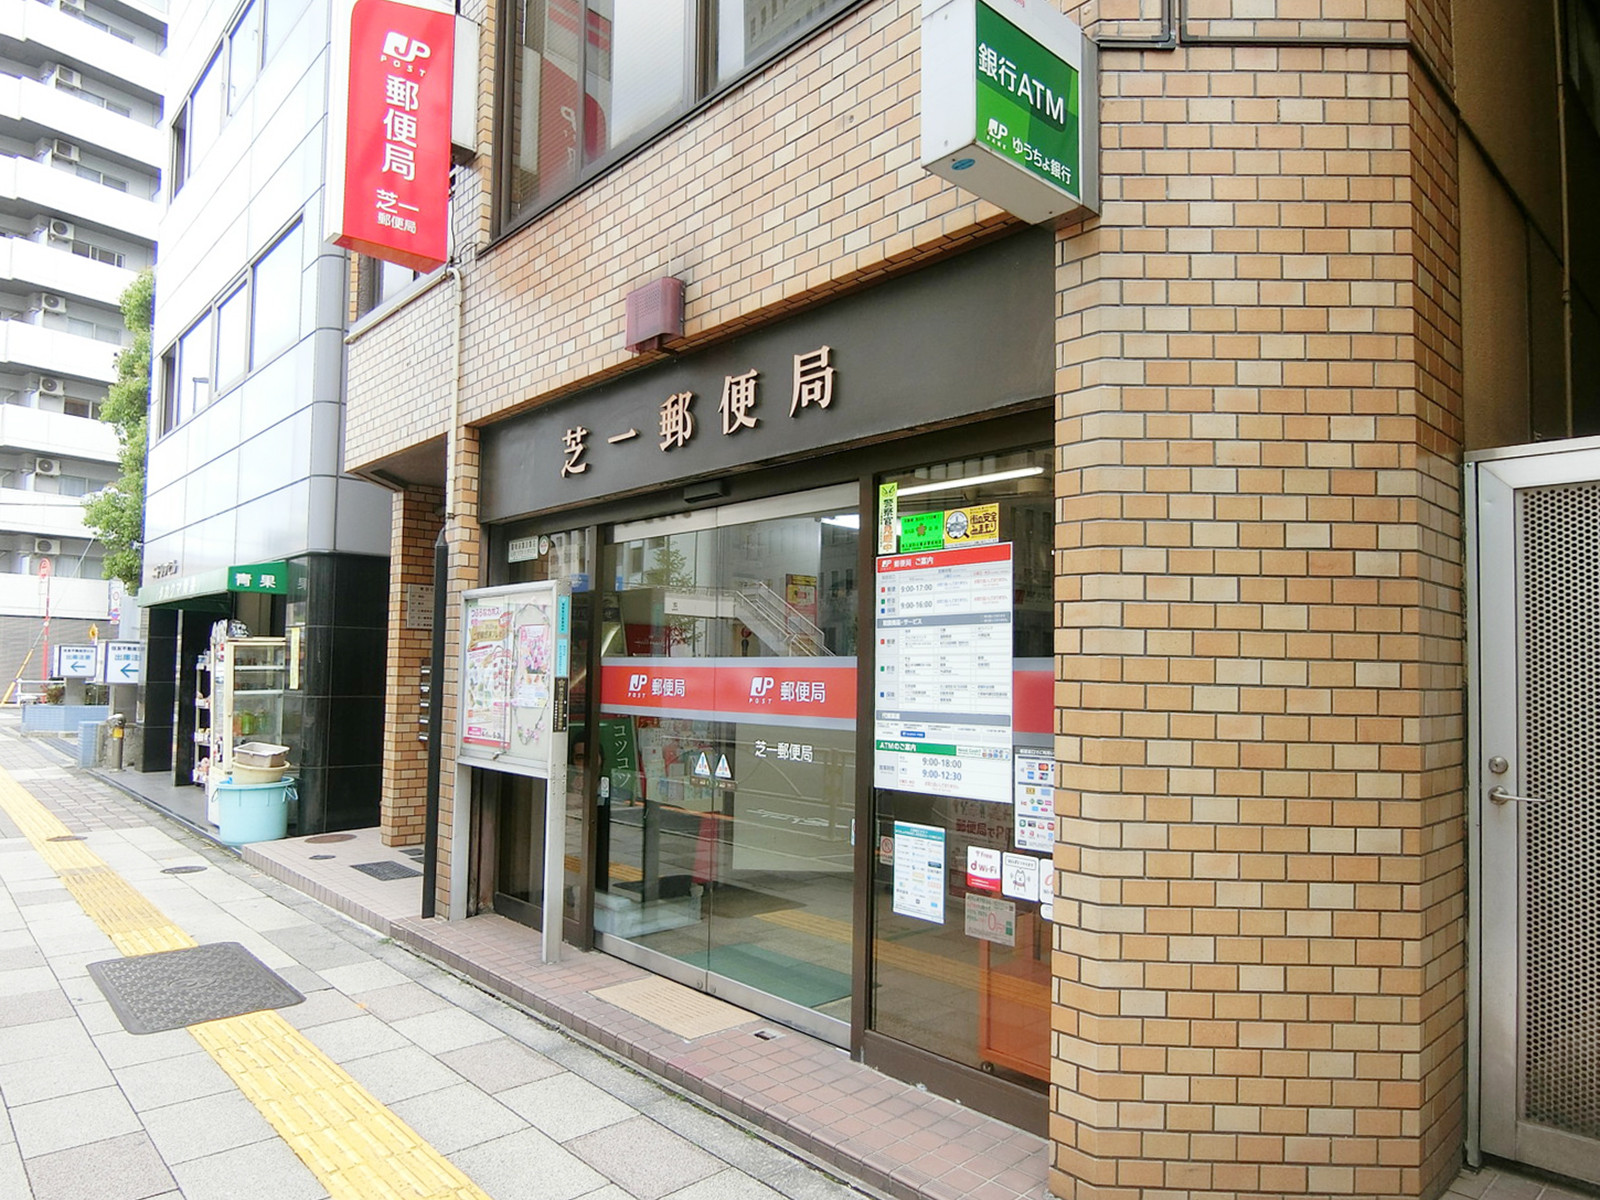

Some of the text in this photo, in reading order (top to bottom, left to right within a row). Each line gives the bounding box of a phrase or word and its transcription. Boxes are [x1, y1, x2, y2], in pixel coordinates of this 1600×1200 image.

[380, 55, 426, 77] POST
[978, 43, 1064, 124] 銀行ATM
[381, 74, 419, 182] 郵便局
[1012, 136, 1071, 184] ゆうちょ銀行
[376, 189, 420, 214] 芝一
[377, 212, 417, 234] 郵便局
[560, 345, 837, 478] 芝一郵便局
[235, 572, 276, 588] 青果
[900, 584, 933, 593] 9:00-17:00
[900, 600, 933, 609] 9:00-16:00
[651, 678, 686, 697] 郵便局
[780, 681, 826, 704] 郵便局
[613, 724, 631, 788] コツコツ
[754, 740, 813, 763] 芝一郵便局
[879, 741, 917, 752] ATMのご案内
[922, 757, 962, 769] 9:00-18:00
[922, 769, 962, 781] 9:00-12:30
[979, 863, 997, 874] Wi-Fi
